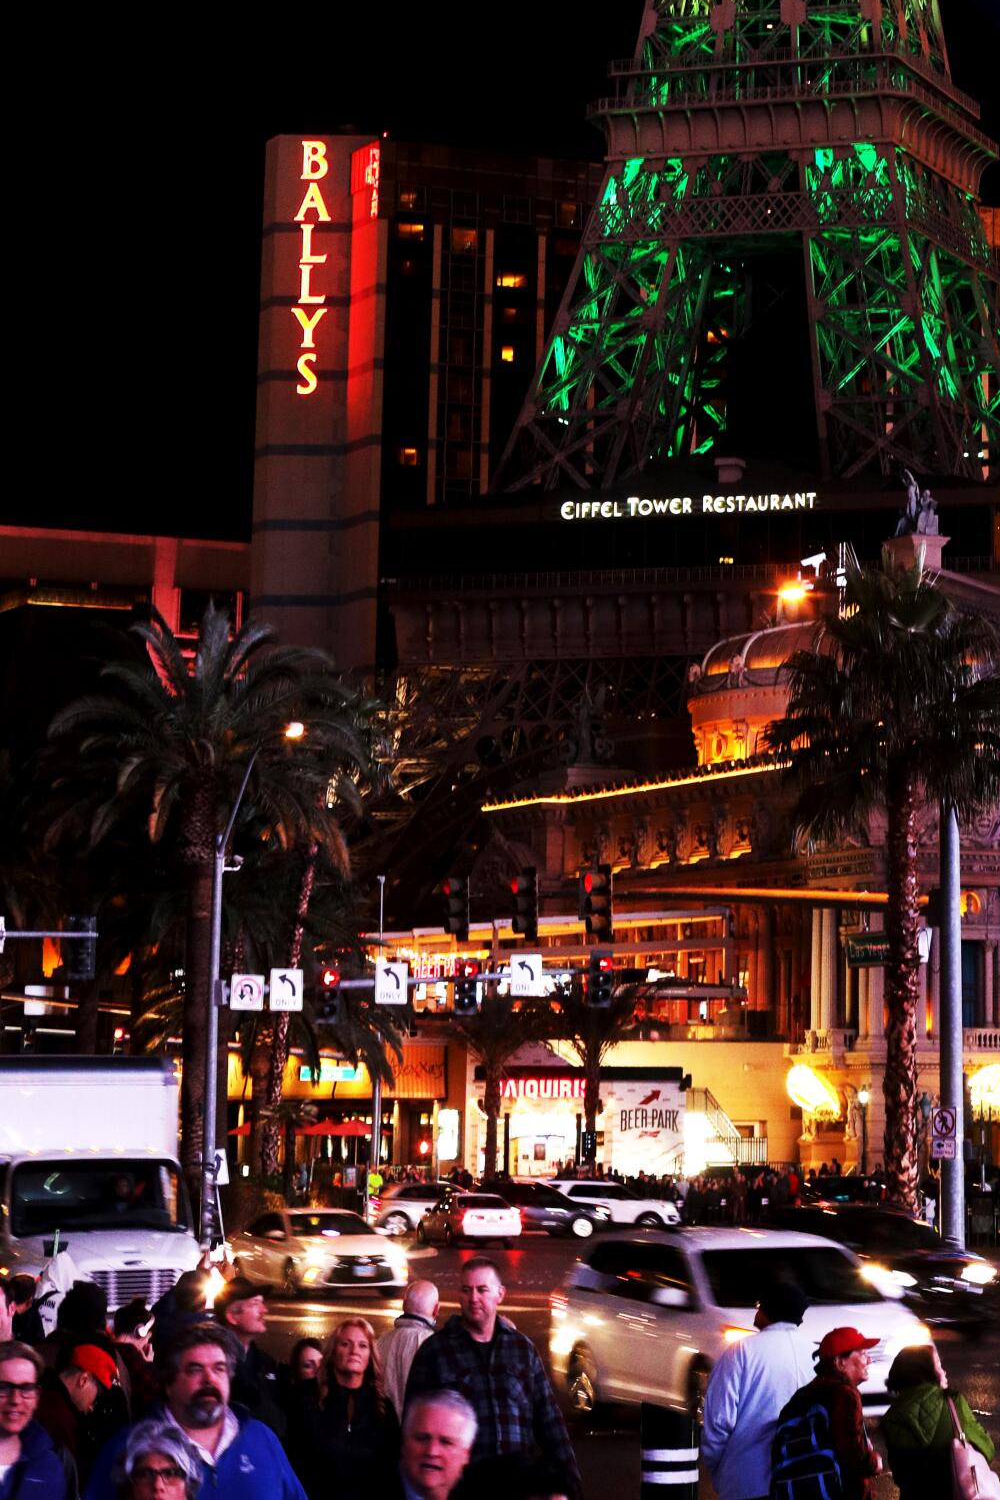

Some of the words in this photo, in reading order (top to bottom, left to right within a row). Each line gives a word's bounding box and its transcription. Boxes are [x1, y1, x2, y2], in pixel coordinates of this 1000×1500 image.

[291, 140, 332, 395] BALLYS
[560, 501, 622, 520] EIFFEL
[627, 497, 692, 516] TOWER
[702, 492, 817, 513] RESTAURANT
[380, 990, 401, 1000] ONLY
[620, 1107, 648, 1132] BEER
[651, 1107, 680, 1132] PARK
